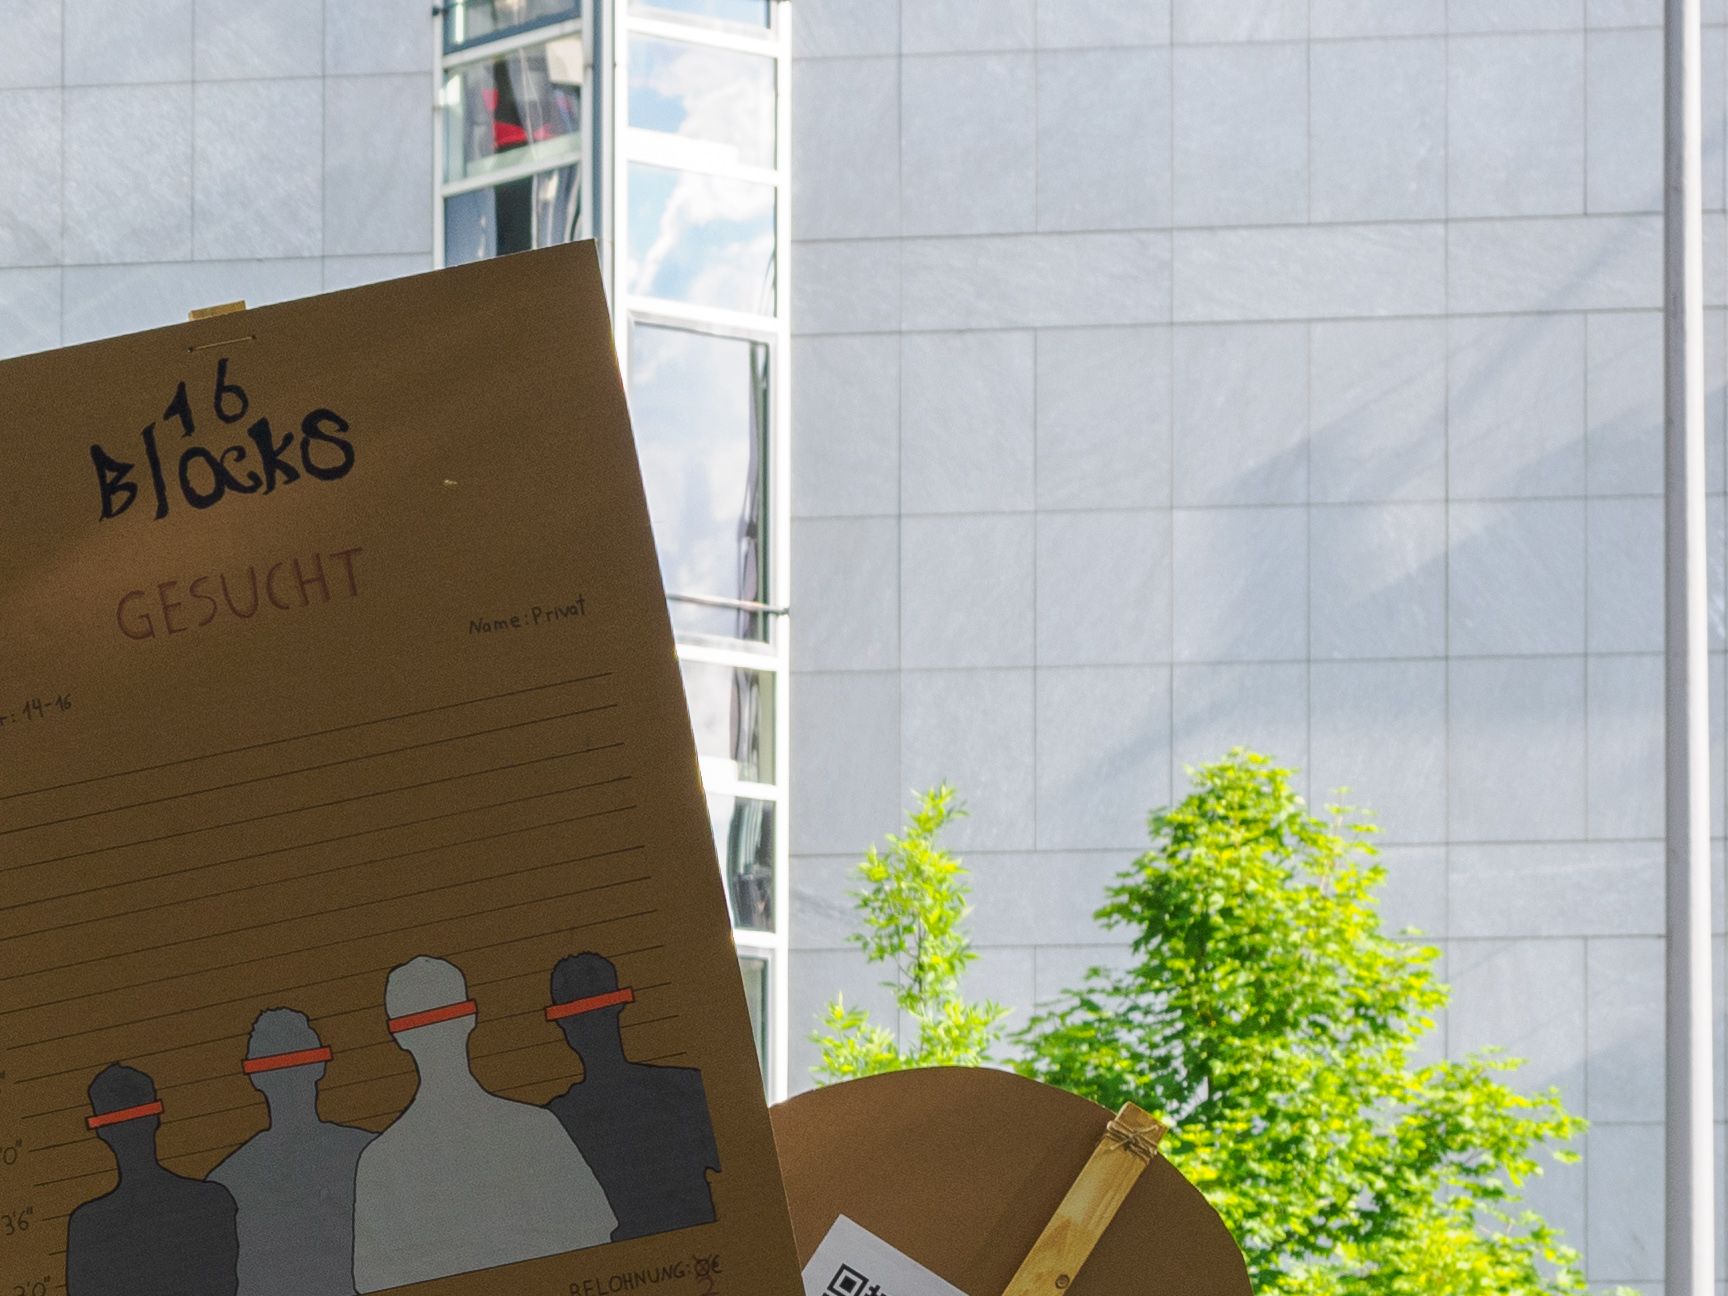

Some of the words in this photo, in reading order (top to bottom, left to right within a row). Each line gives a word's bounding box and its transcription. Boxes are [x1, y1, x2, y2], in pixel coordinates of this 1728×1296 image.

[162, 357, 250, 438] 16
[116, 546, 364, 640] GESUCHT
[22, 693, 72, 721] 14-16
